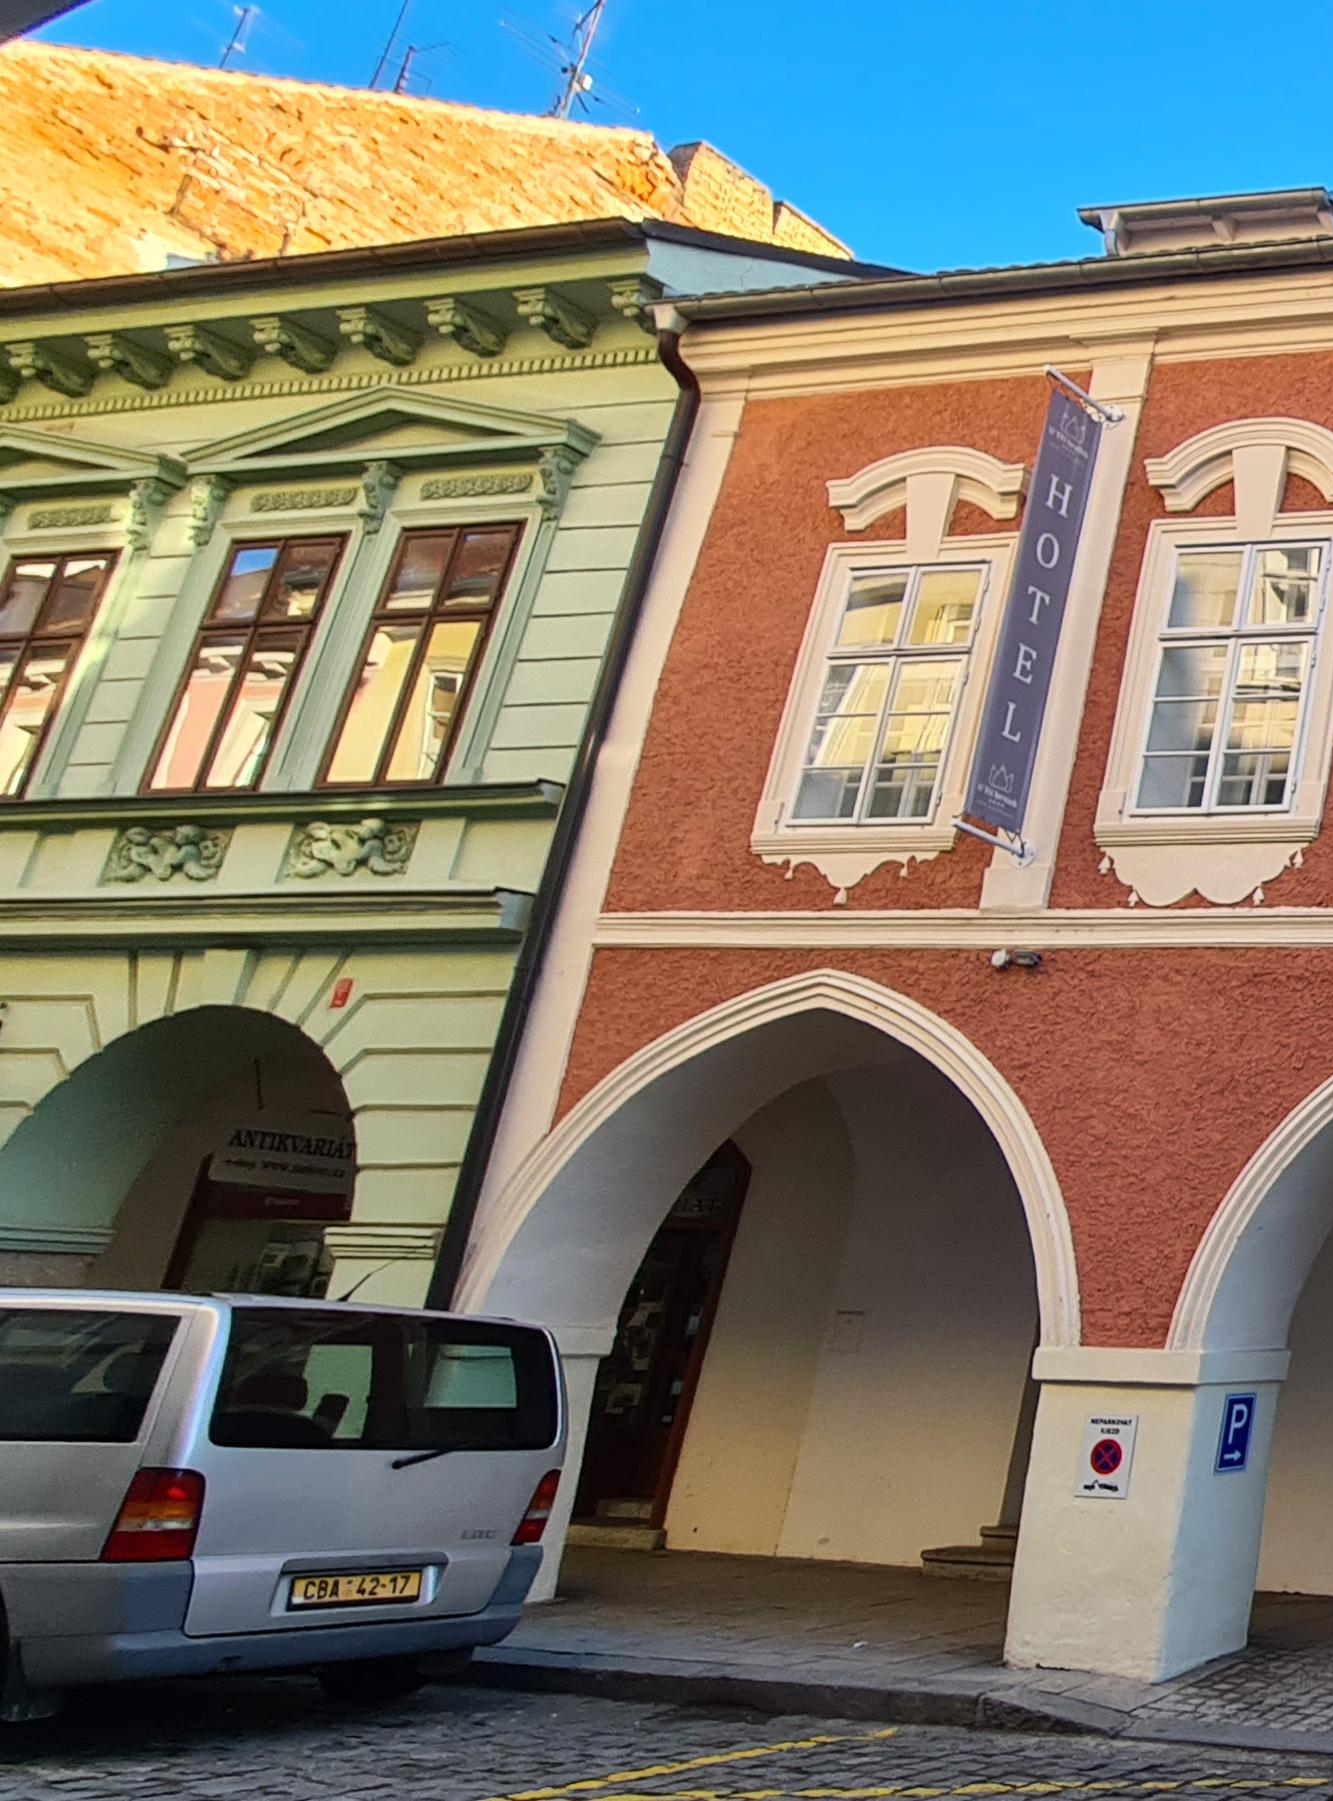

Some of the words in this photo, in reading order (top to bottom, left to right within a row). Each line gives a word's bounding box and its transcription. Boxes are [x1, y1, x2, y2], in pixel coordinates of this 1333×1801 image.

[1001, 473, 1074, 742] HOTEL
[1227, 1403, 1248, 1445] P
[303, 1579, 340, 1600] CBA
[356, 1575, 412, 1597] 42-17
